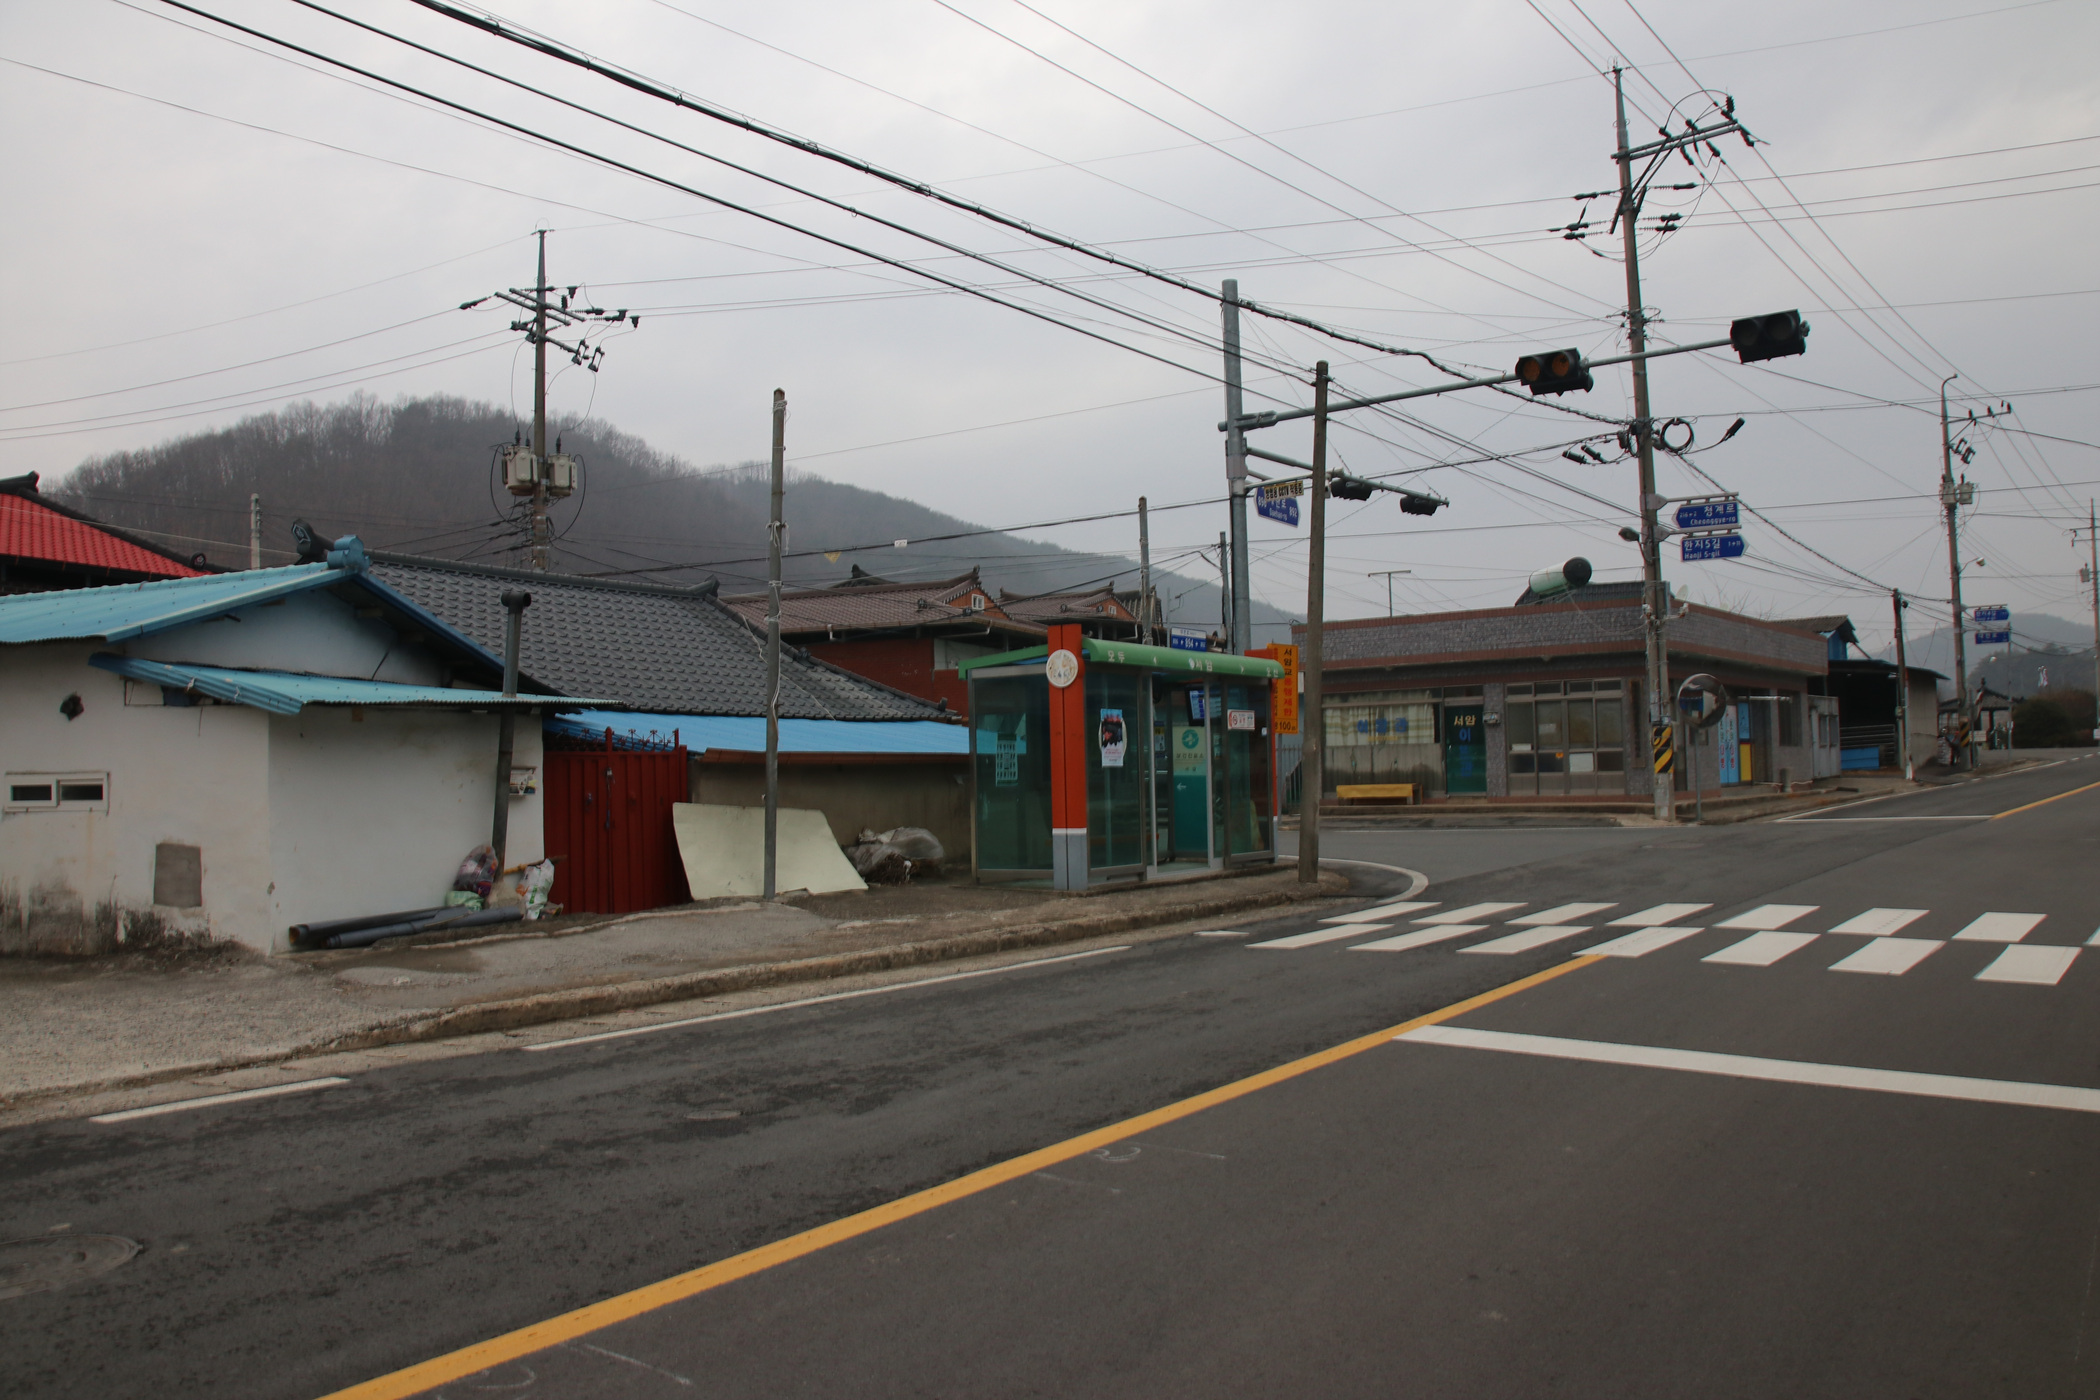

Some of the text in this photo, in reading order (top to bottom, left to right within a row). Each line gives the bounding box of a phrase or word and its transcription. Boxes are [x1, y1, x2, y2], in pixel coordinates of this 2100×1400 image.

[1278, 486, 1289, 496] CCTV
[1704, 504, 1735, 517] 청계로
[1690, 517, 1736, 526] Cheonggye-ro
[1684, 538, 1720, 550] 한지5길
[1684, 550, 1720, 560] Hanji 5-gil
[1454, 715, 1476, 726] 서암
